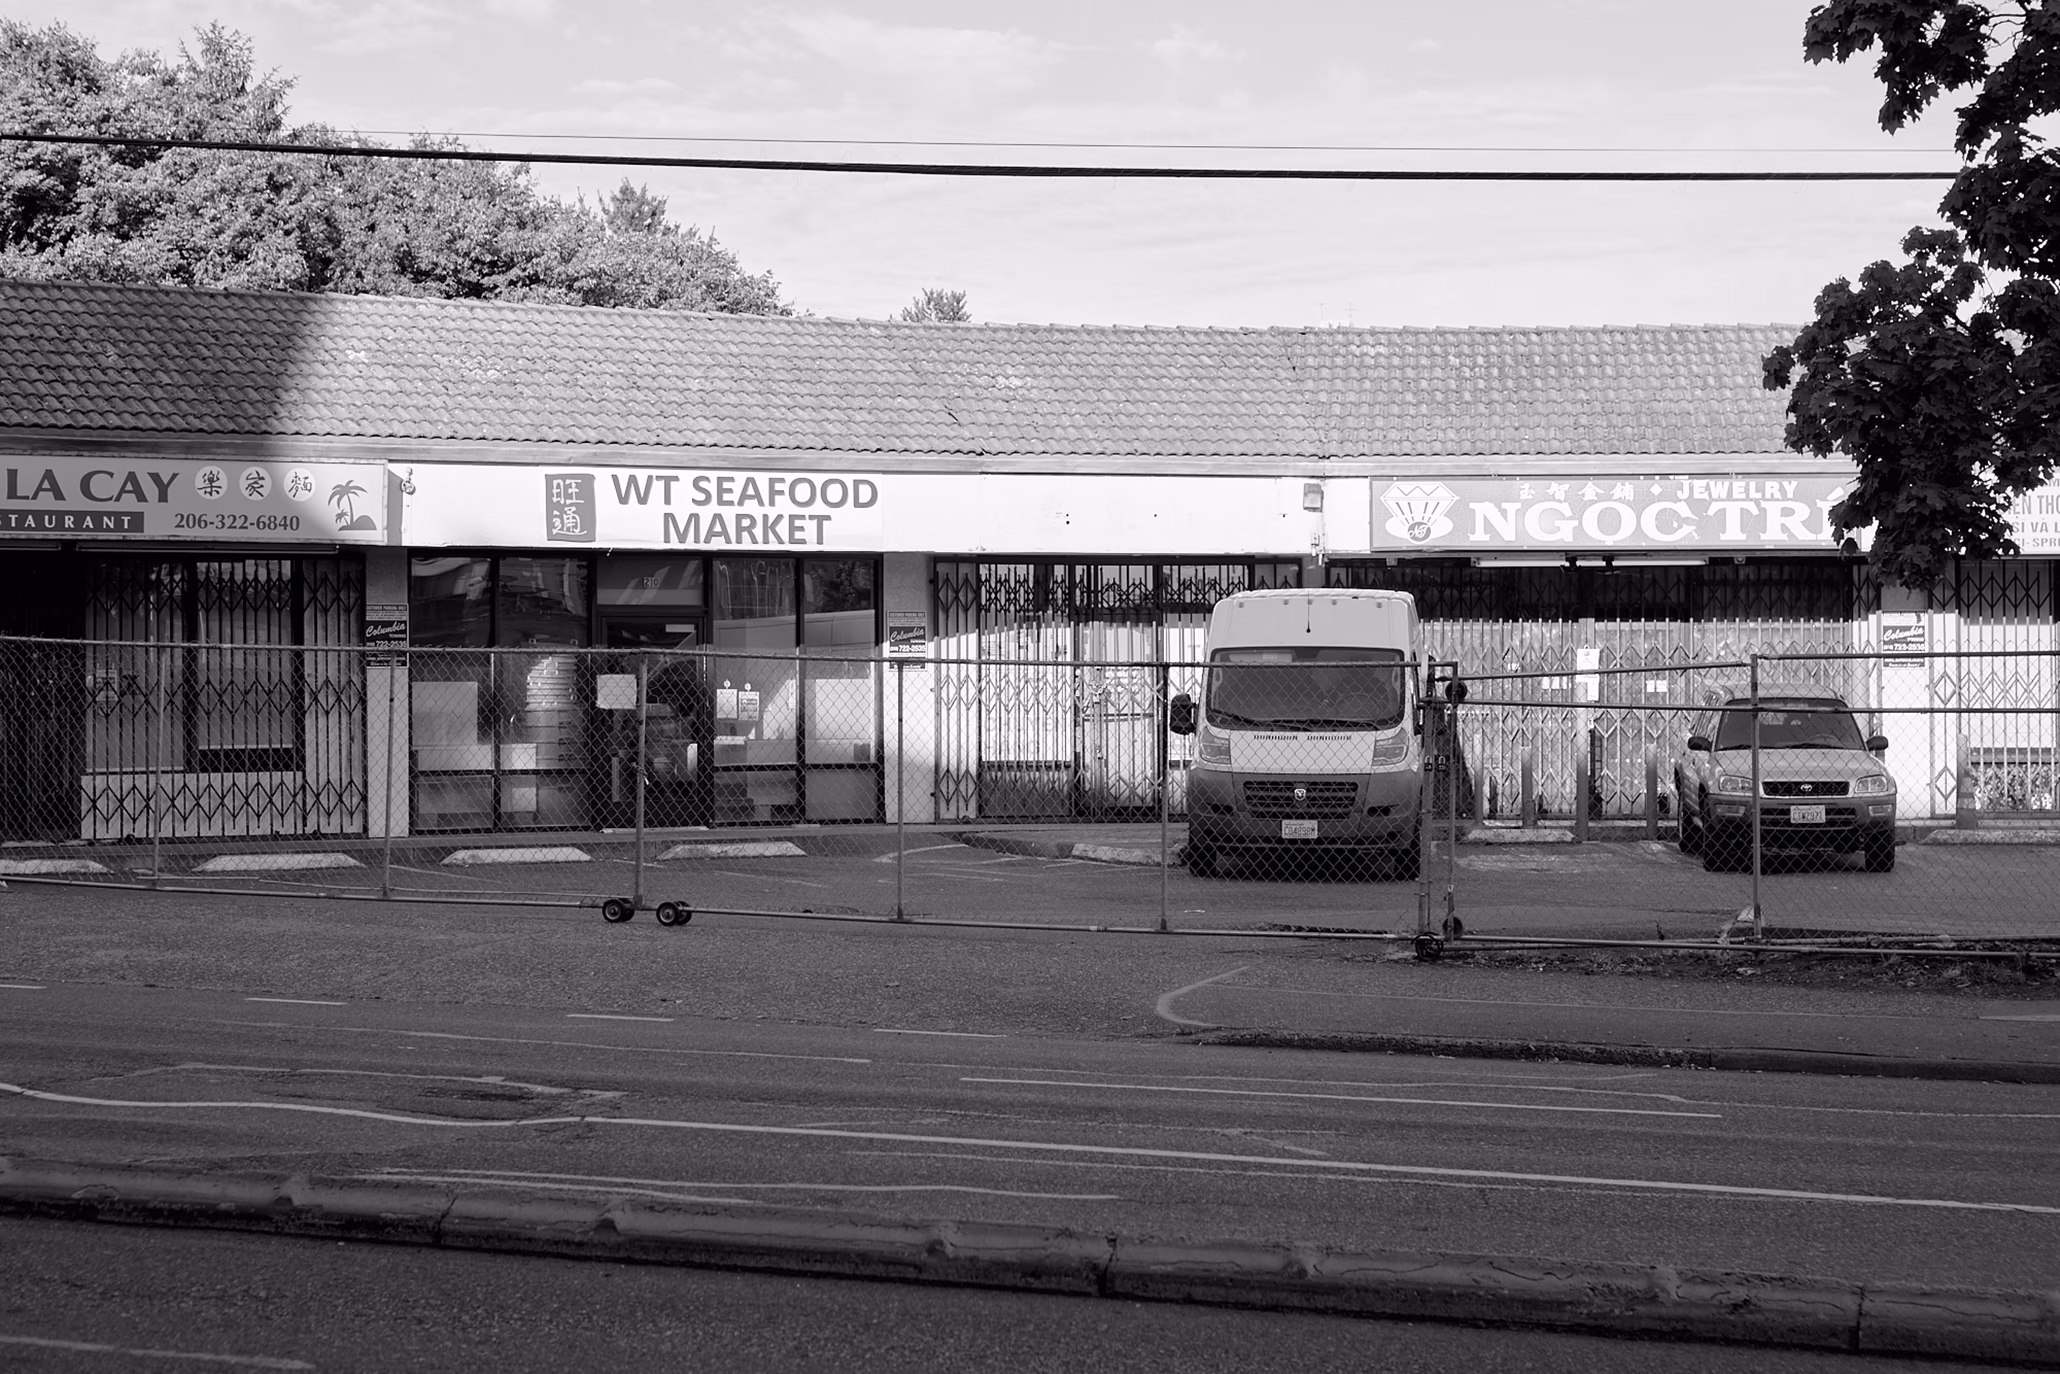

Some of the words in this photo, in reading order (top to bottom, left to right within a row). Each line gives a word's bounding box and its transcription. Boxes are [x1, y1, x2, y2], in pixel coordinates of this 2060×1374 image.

[6, 468, 67, 502] LA
[79, 469, 180, 503] CAY
[611, 473, 680, 506] WT
[691, 475, 879, 509] SEAFOOD
[1677, 479, 1799, 500] JEWELRY
[552, 478, 588, 536] 旺通
[0, 514, 132, 529] TAURANT
[174, 513, 301, 531] 206-322-6840
[662, 511, 832, 546] MARKET
[643, 577, 659, 587] 210
[366, 621, 406, 637] Columbia
[890, 627, 925, 643] Columbia
[1883, 625, 1924, 642] Columbia
[375, 640, 407, 648] 722-2535
[1893, 643, 1925, 651] 722-2535
